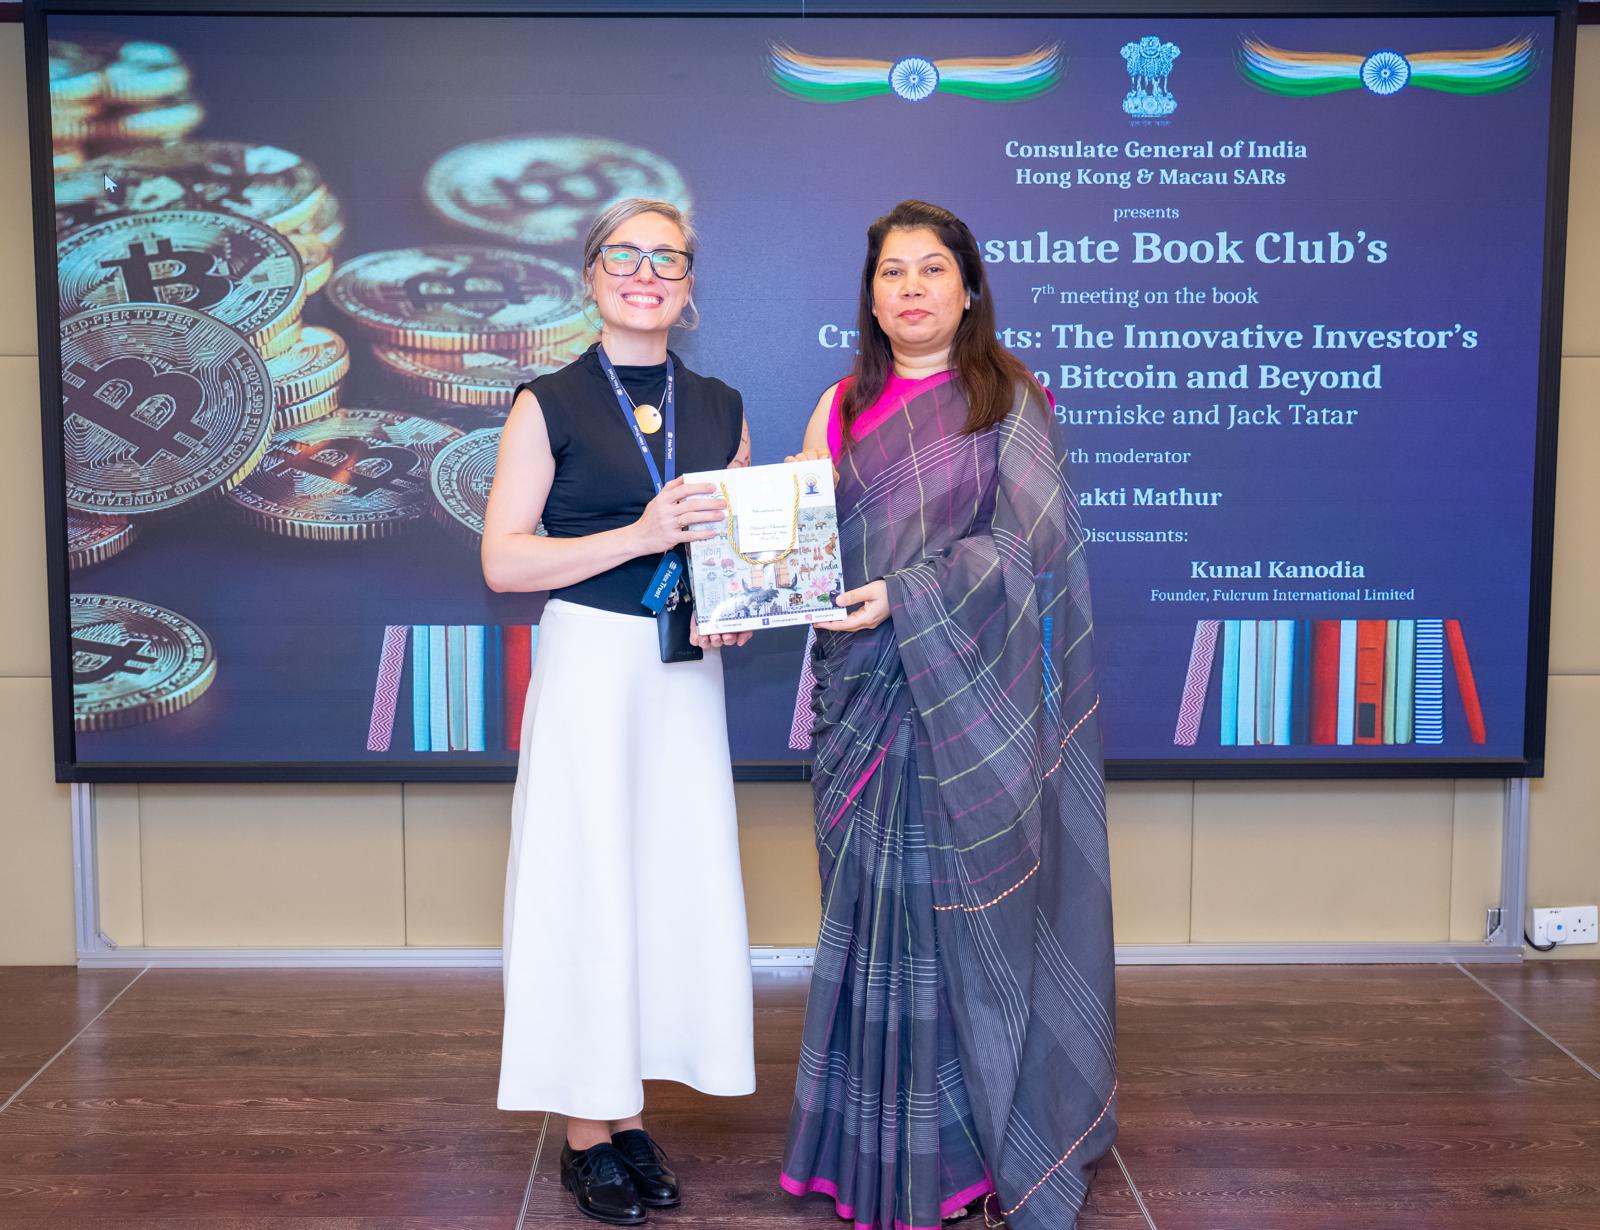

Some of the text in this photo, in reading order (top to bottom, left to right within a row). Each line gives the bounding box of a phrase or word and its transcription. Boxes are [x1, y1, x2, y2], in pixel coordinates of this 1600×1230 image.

[1005, 139, 1307, 159] Consulate General of India
[1015, 168, 1286, 190] Hong Kong & Macau SARs
[1112, 206, 1180, 223] presents
[977, 230, 1388, 264] sulate Book Club’s
[1031, 284, 1259, 309] 7th meeting on the book
[1051, 323, 1114, 349] The
[1123, 323, 1304, 349] Innovative
[1312, 323, 1478, 349] Investor’s
[1033, 364, 1382, 395] o Bitcoin and Beyond
[1054, 404, 1359, 430] Burniske and Jack Tatar
[1070, 447, 1192, 464] th moderator
[1079, 487, 1223, 506] akti Mathur
[1083, 527, 1188, 543] Discussants:
[1190, 560, 1366, 579] Kunal Kanodia
[1150, 588, 1415, 602] Founder, Fulcrum International Limited
